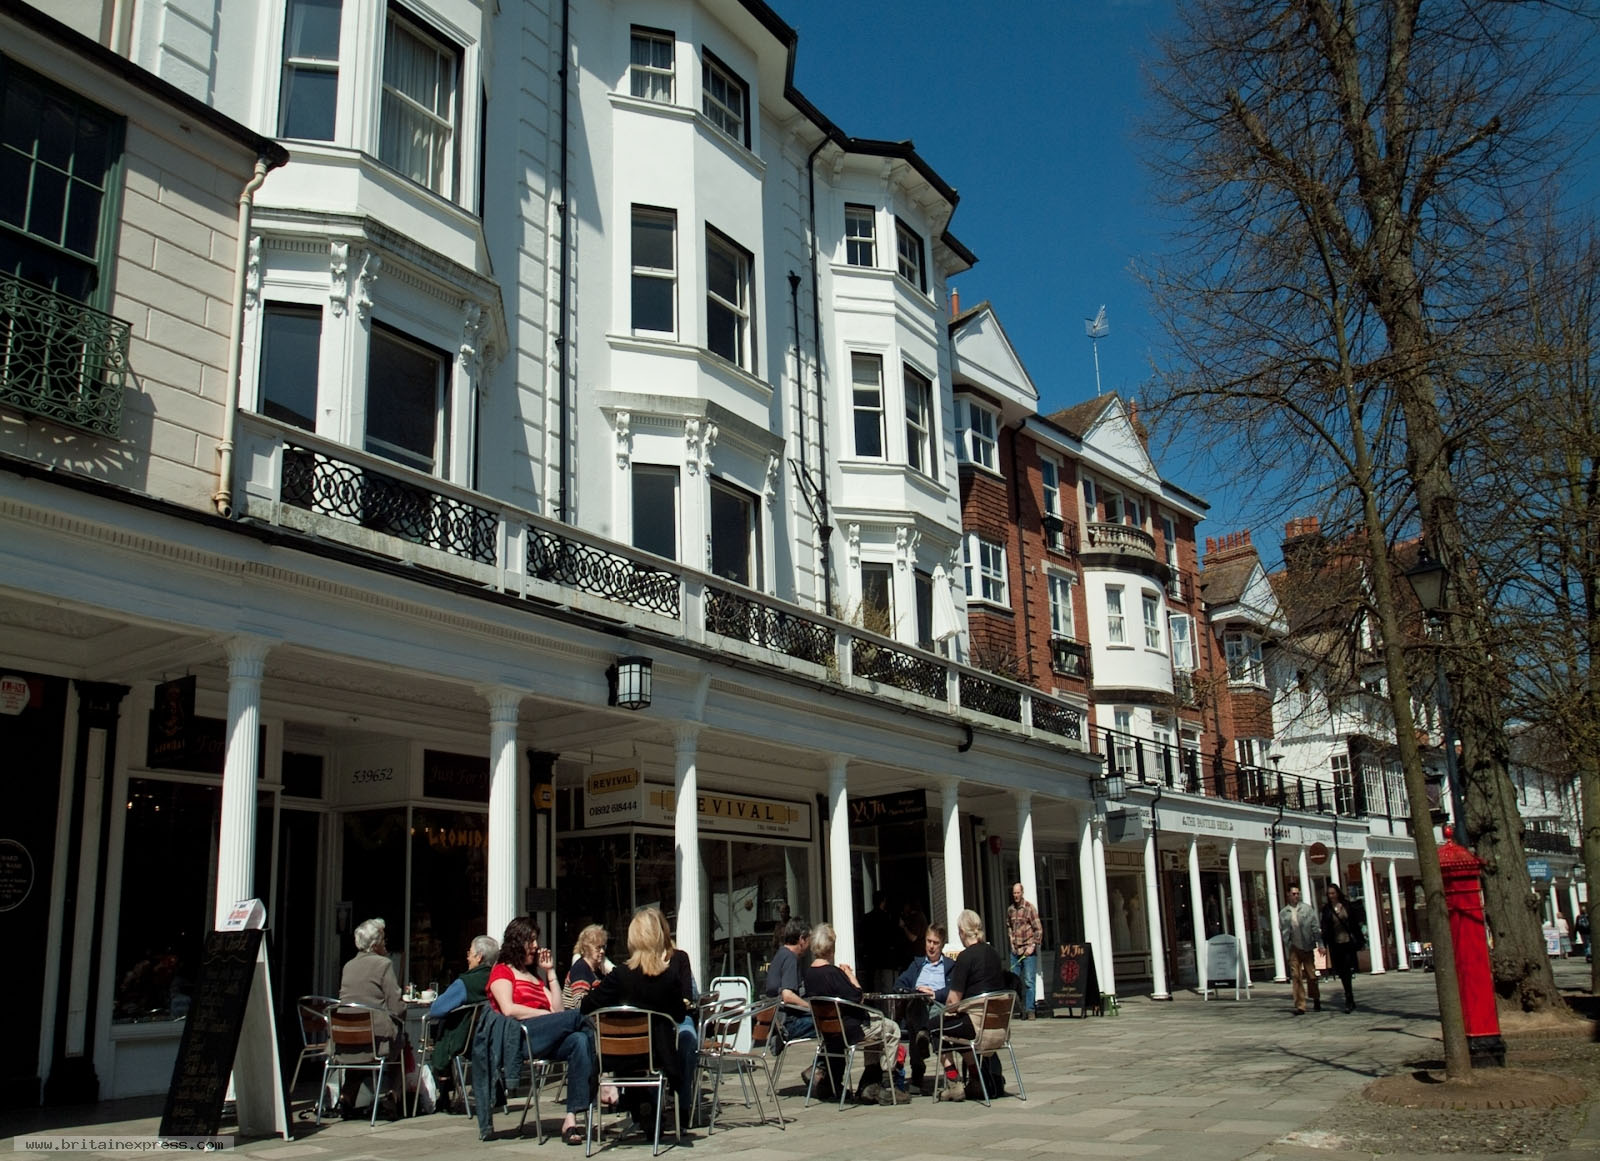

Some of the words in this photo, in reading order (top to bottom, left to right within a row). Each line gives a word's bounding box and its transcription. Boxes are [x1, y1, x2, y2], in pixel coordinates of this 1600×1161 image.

[351, 767, 393, 784] 539652
[593, 774, 633, 790] REVIVAL
[697, 797, 774, 820] EVIVAL
